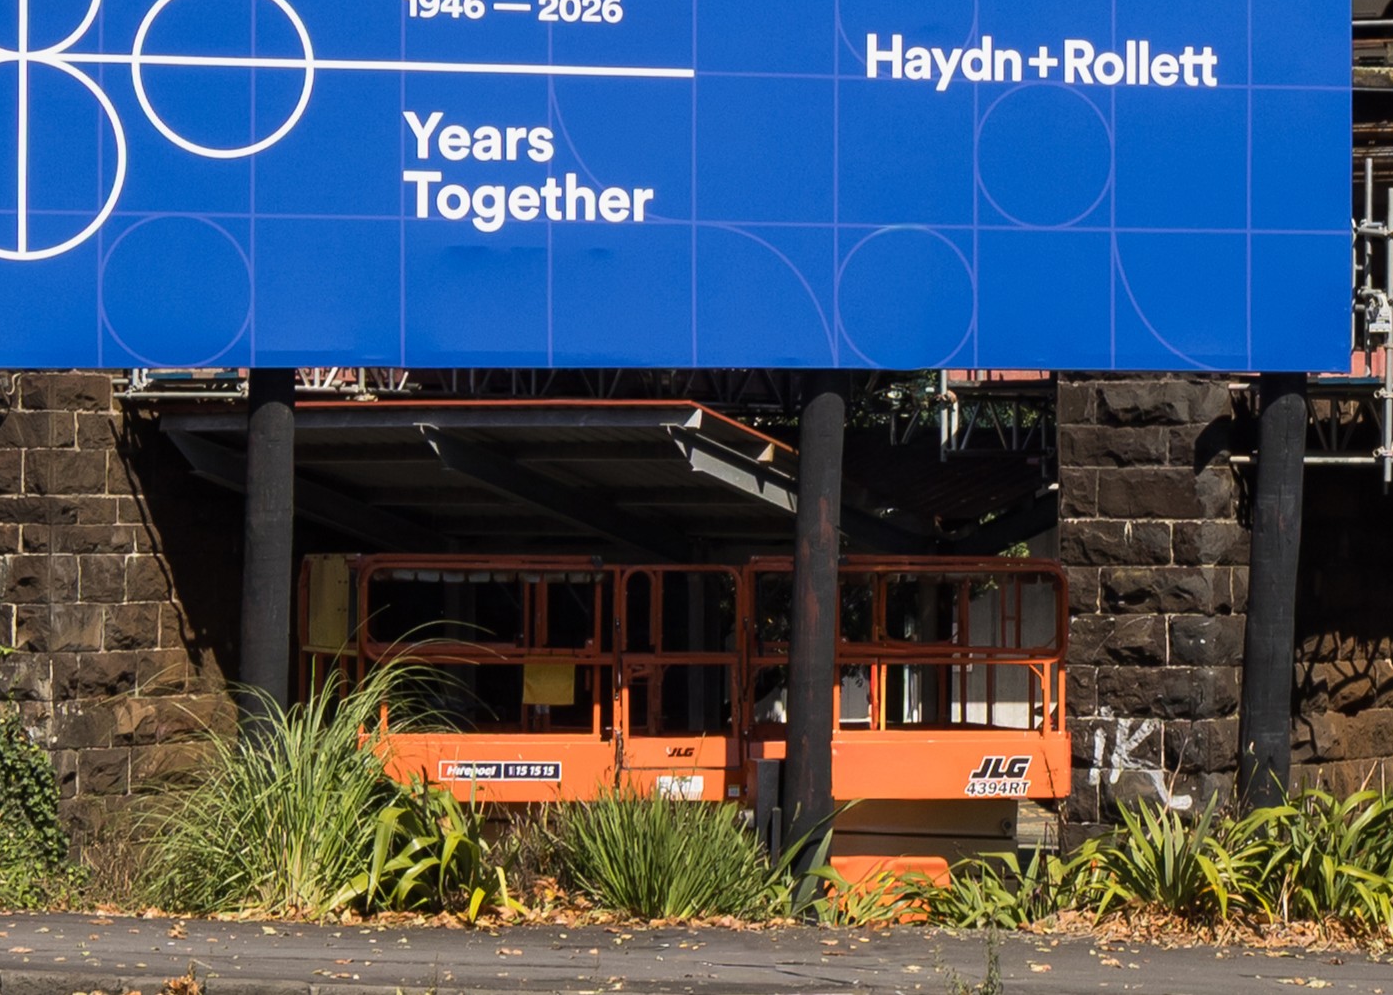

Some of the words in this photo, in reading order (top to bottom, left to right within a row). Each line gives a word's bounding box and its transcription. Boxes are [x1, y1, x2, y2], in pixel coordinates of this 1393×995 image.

[402, 111, 554, 163] Years
[402, 170, 654, 233] Together
[667, 747, 695, 758] JLG
[970, 757, 1031, 779] JLG
[966, 781, 1030, 795] 4394RT
